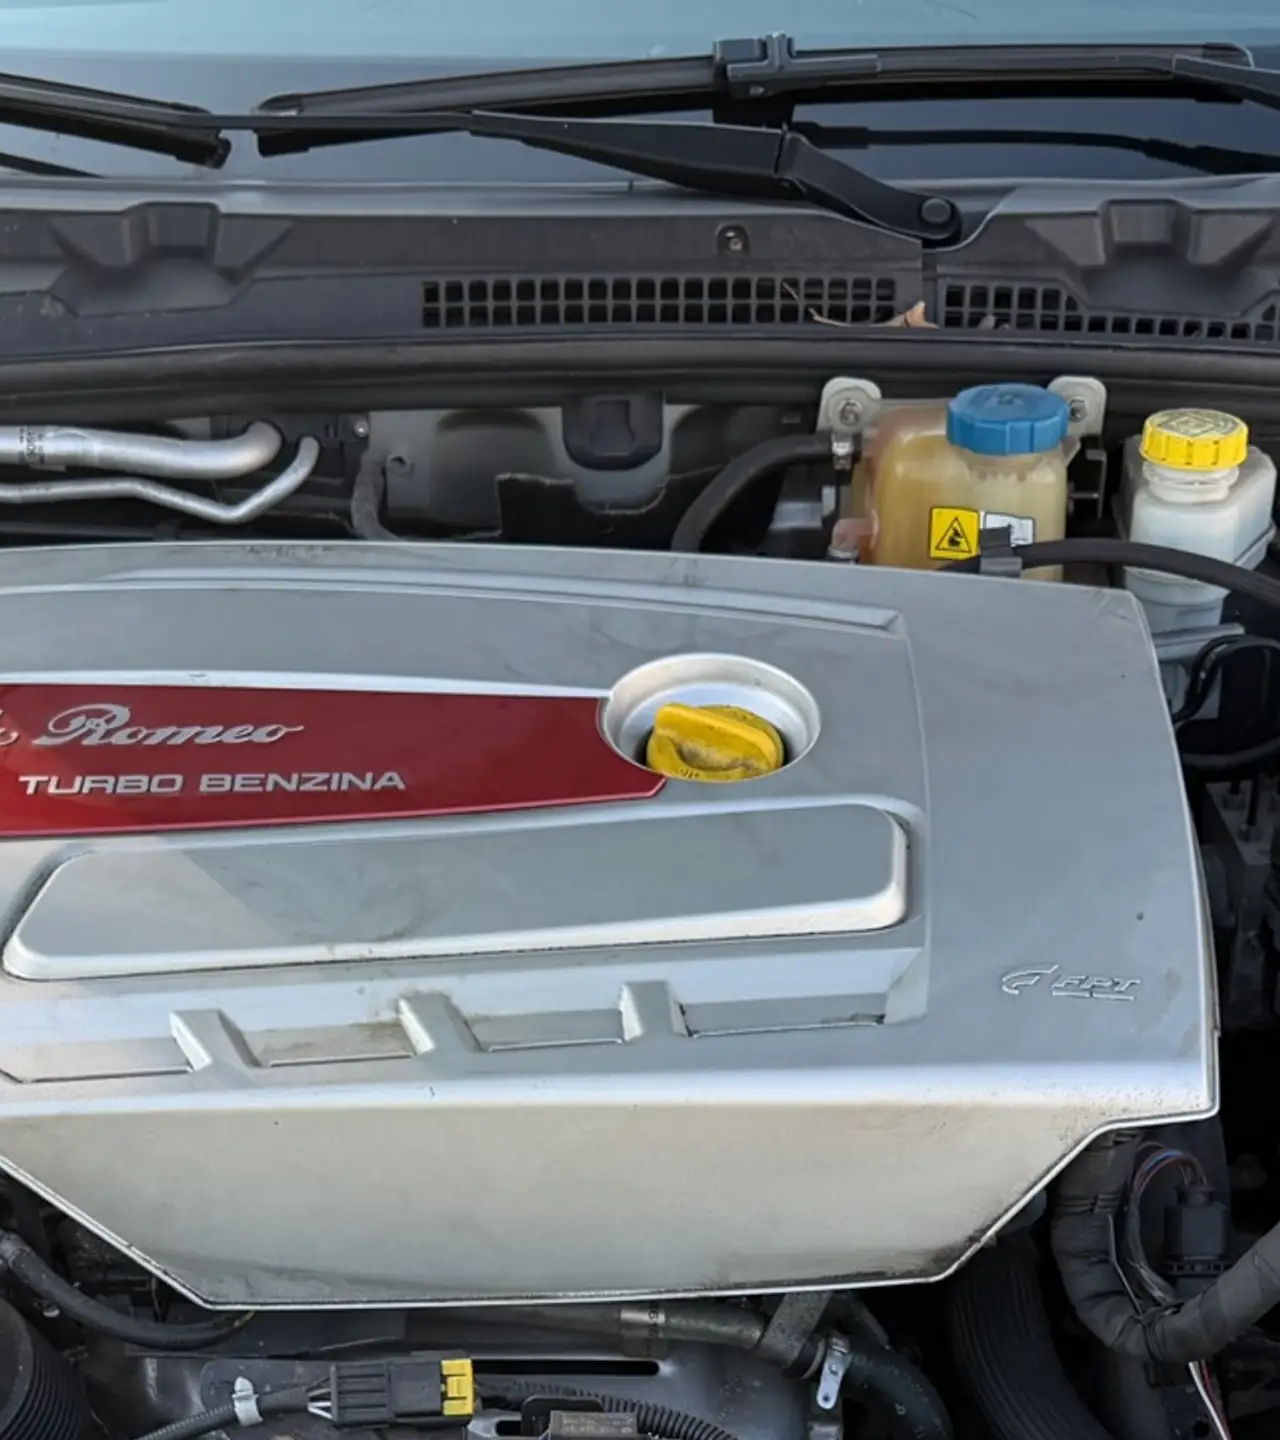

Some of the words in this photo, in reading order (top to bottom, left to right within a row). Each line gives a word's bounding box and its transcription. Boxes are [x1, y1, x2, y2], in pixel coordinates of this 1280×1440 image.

[32, 703, 305, 746] Romeo
[17, 774, 186, 797] TURBO
[198, 771, 408, 794] BENZINA
